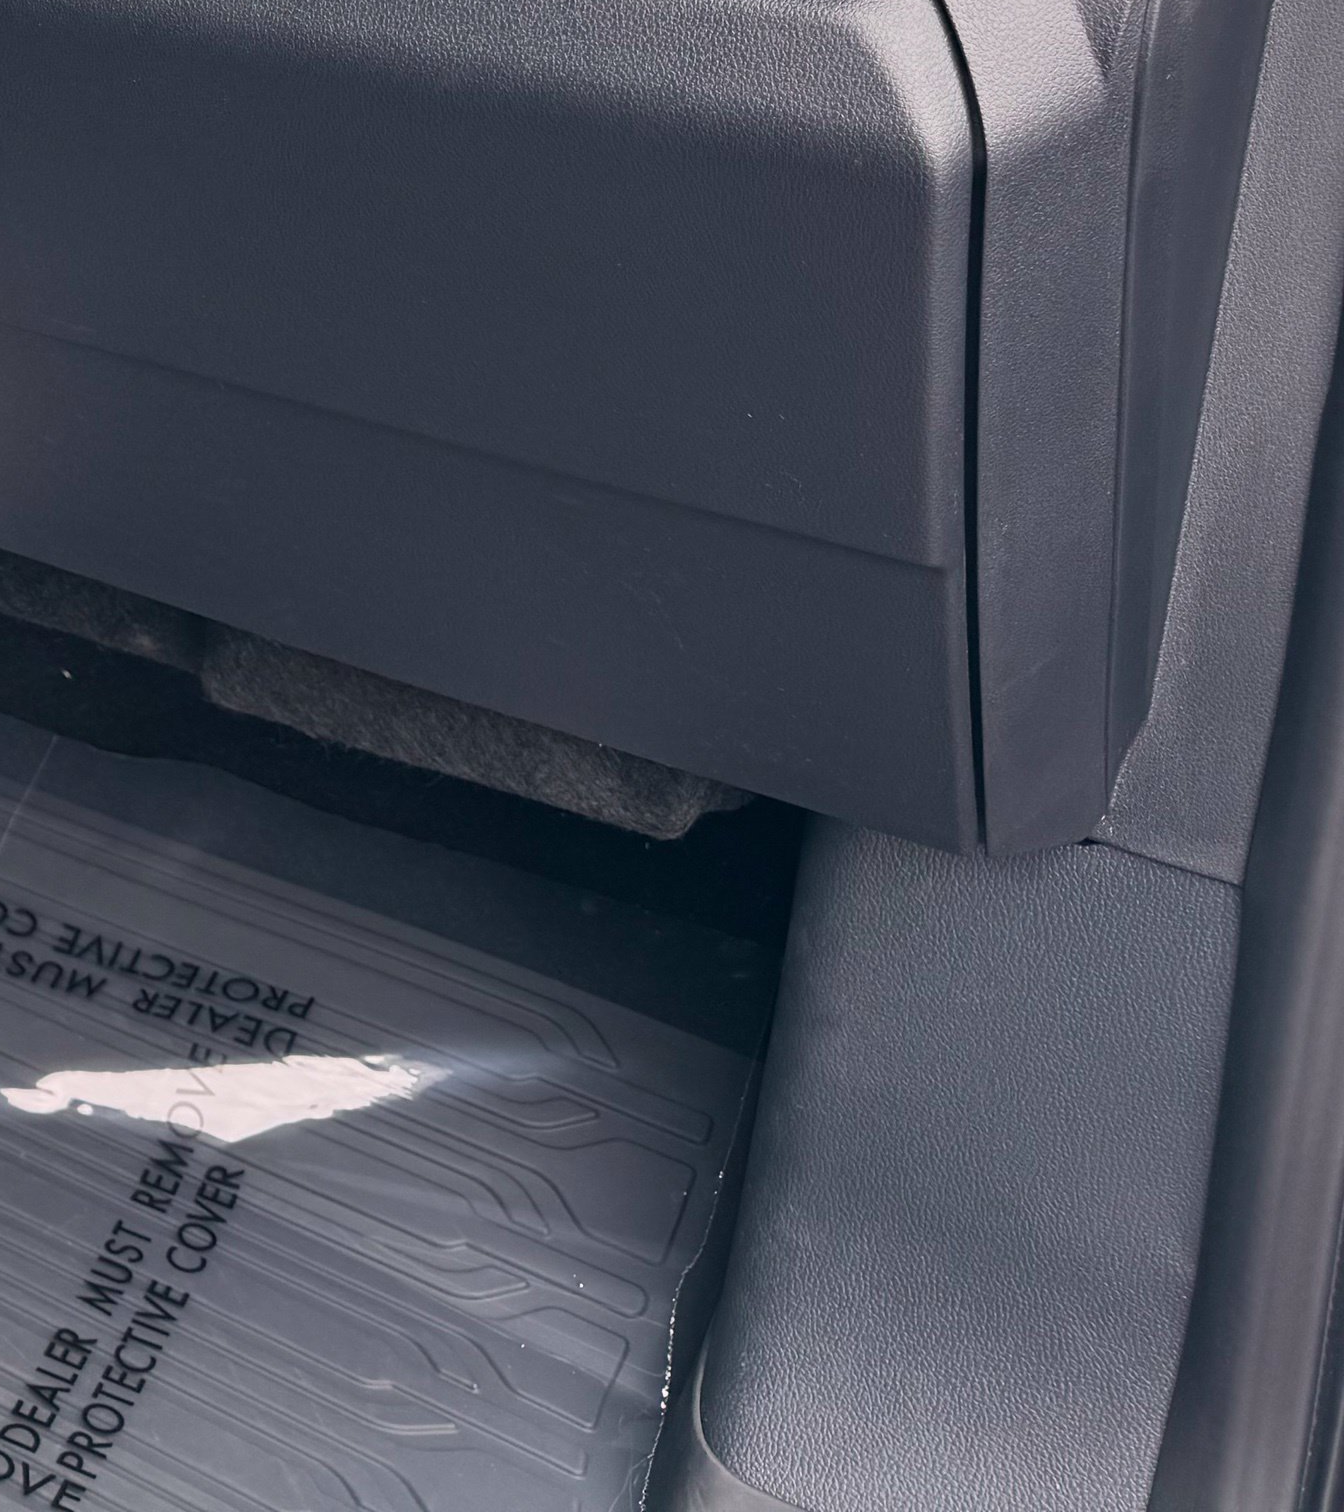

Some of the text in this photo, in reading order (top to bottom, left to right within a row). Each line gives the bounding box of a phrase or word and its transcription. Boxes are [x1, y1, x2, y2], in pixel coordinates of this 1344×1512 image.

[56, 923, 316, 1020] PROTECTIVE
[132, 986, 300, 1058] DEALER
[75, 1218, 153, 1317] MUST
[55, 1163, 246, 1481] PROTECTIVE COVER
